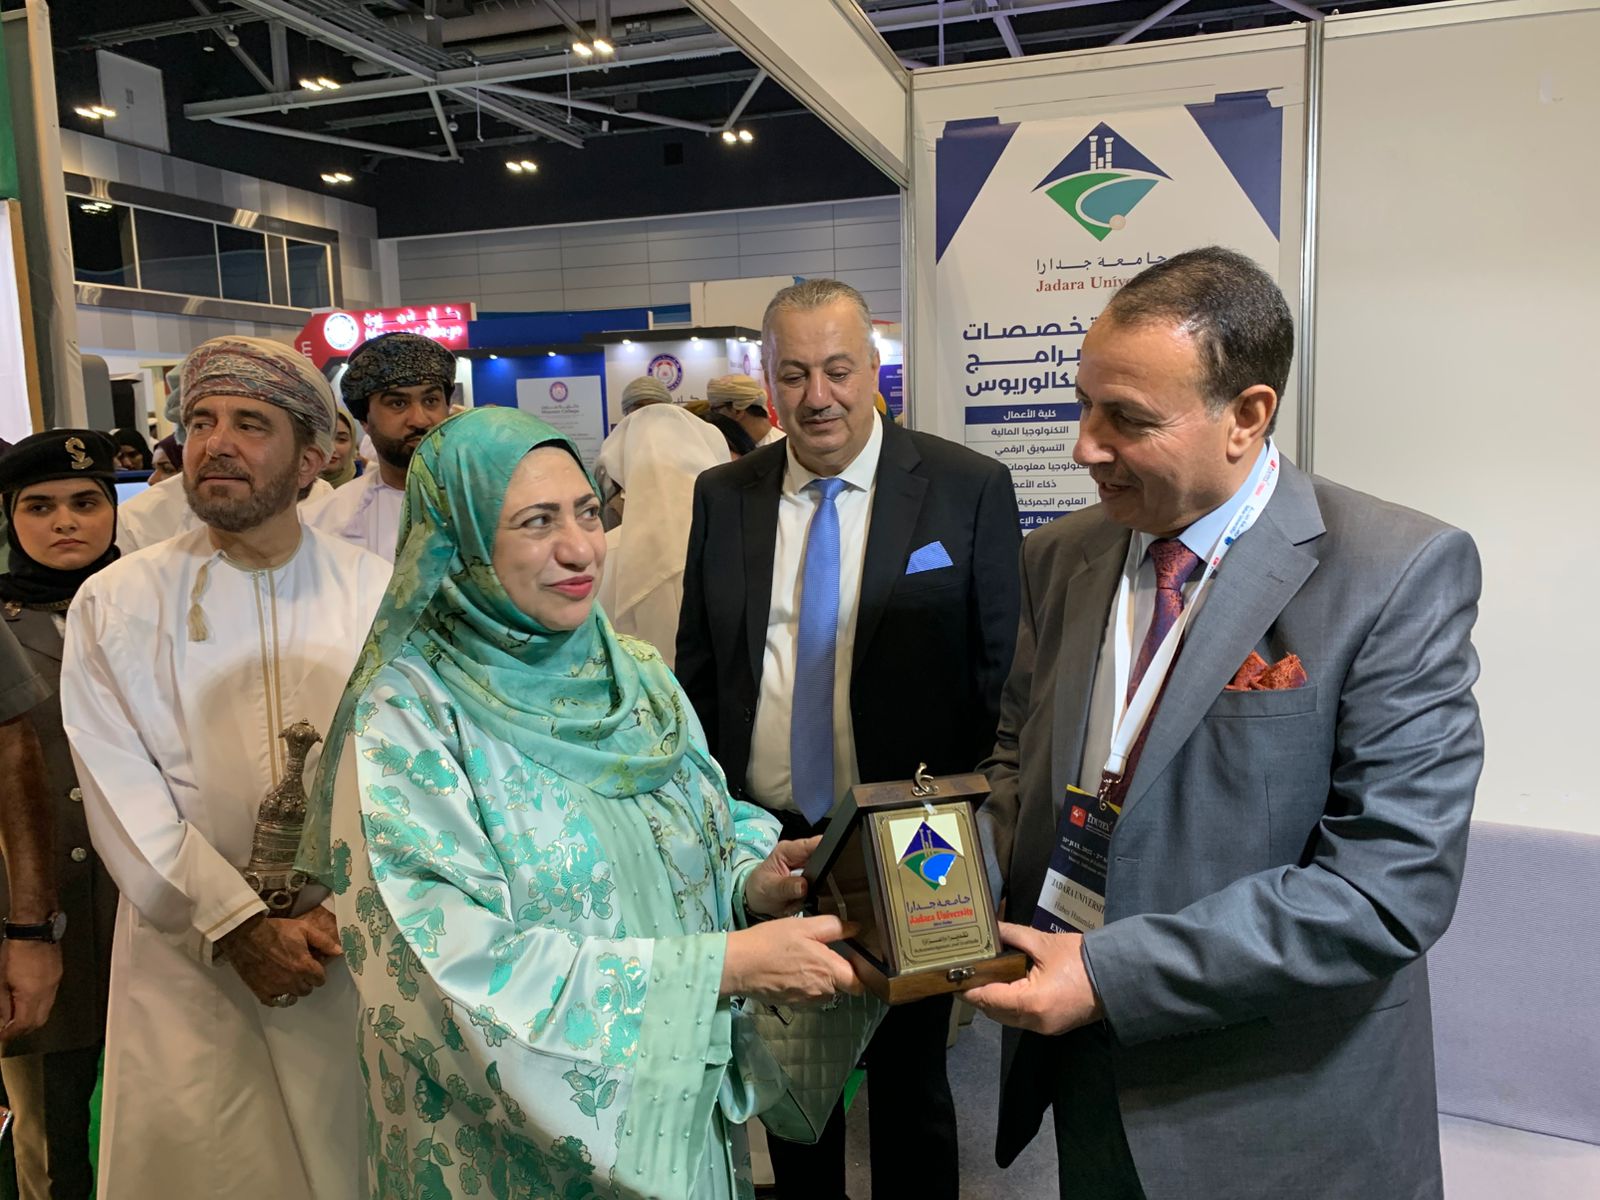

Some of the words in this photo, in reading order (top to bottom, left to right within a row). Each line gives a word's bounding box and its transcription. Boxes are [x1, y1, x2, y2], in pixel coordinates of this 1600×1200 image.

[1098, 252, 1167, 268] جامعة
[1036, 258, 1092, 275] جدارا
[1036, 279, 1086, 293] Jadara
[965, 371, 1077, 397] كالوريوس
[1003, 409, 1036, 420] الأعمال
[1038, 409, 1057, 419] كلية
[991, 427, 1020, 437] المالية
[1022, 426, 1069, 436] التكنولوجيا
[995, 445, 1024, 455] الرقمي
[1026, 444, 1065, 455] التسويق
[1013, 479, 1035, 488] الأعم
[1036, 480, 1057, 488] ذكاء
[1018, 497, 1055, 507] الجمركية
[1057, 497, 1087, 508] العلوم
[1074, 890, 1105, 915] UNIVERSIT
[936, 907, 973, 921] University
